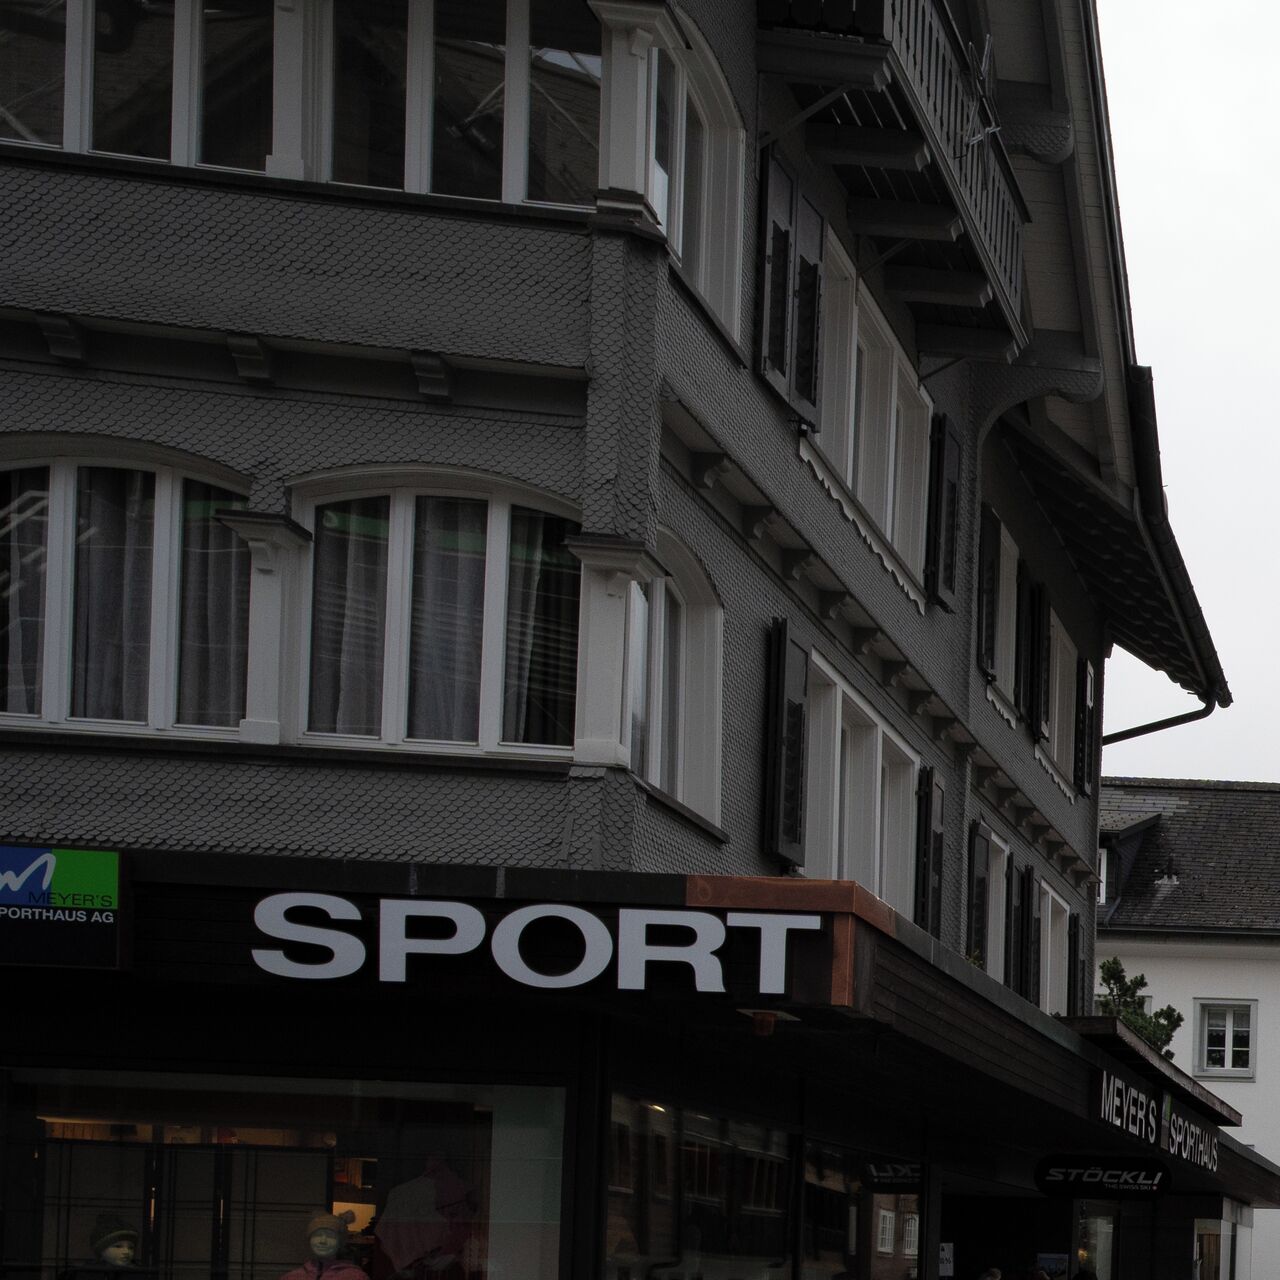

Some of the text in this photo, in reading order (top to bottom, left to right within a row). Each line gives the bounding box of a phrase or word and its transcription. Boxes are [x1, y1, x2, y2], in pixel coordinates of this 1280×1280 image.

[28, 892, 113, 907] MEYER'S
[91, 911, 114, 923] AG
[251, 891, 822, 995] SPORT
[1101, 1070, 1218, 1173] MEYER'S SPORTHAUS
[1045, 1166, 1163, 1185] STÖCKLI
